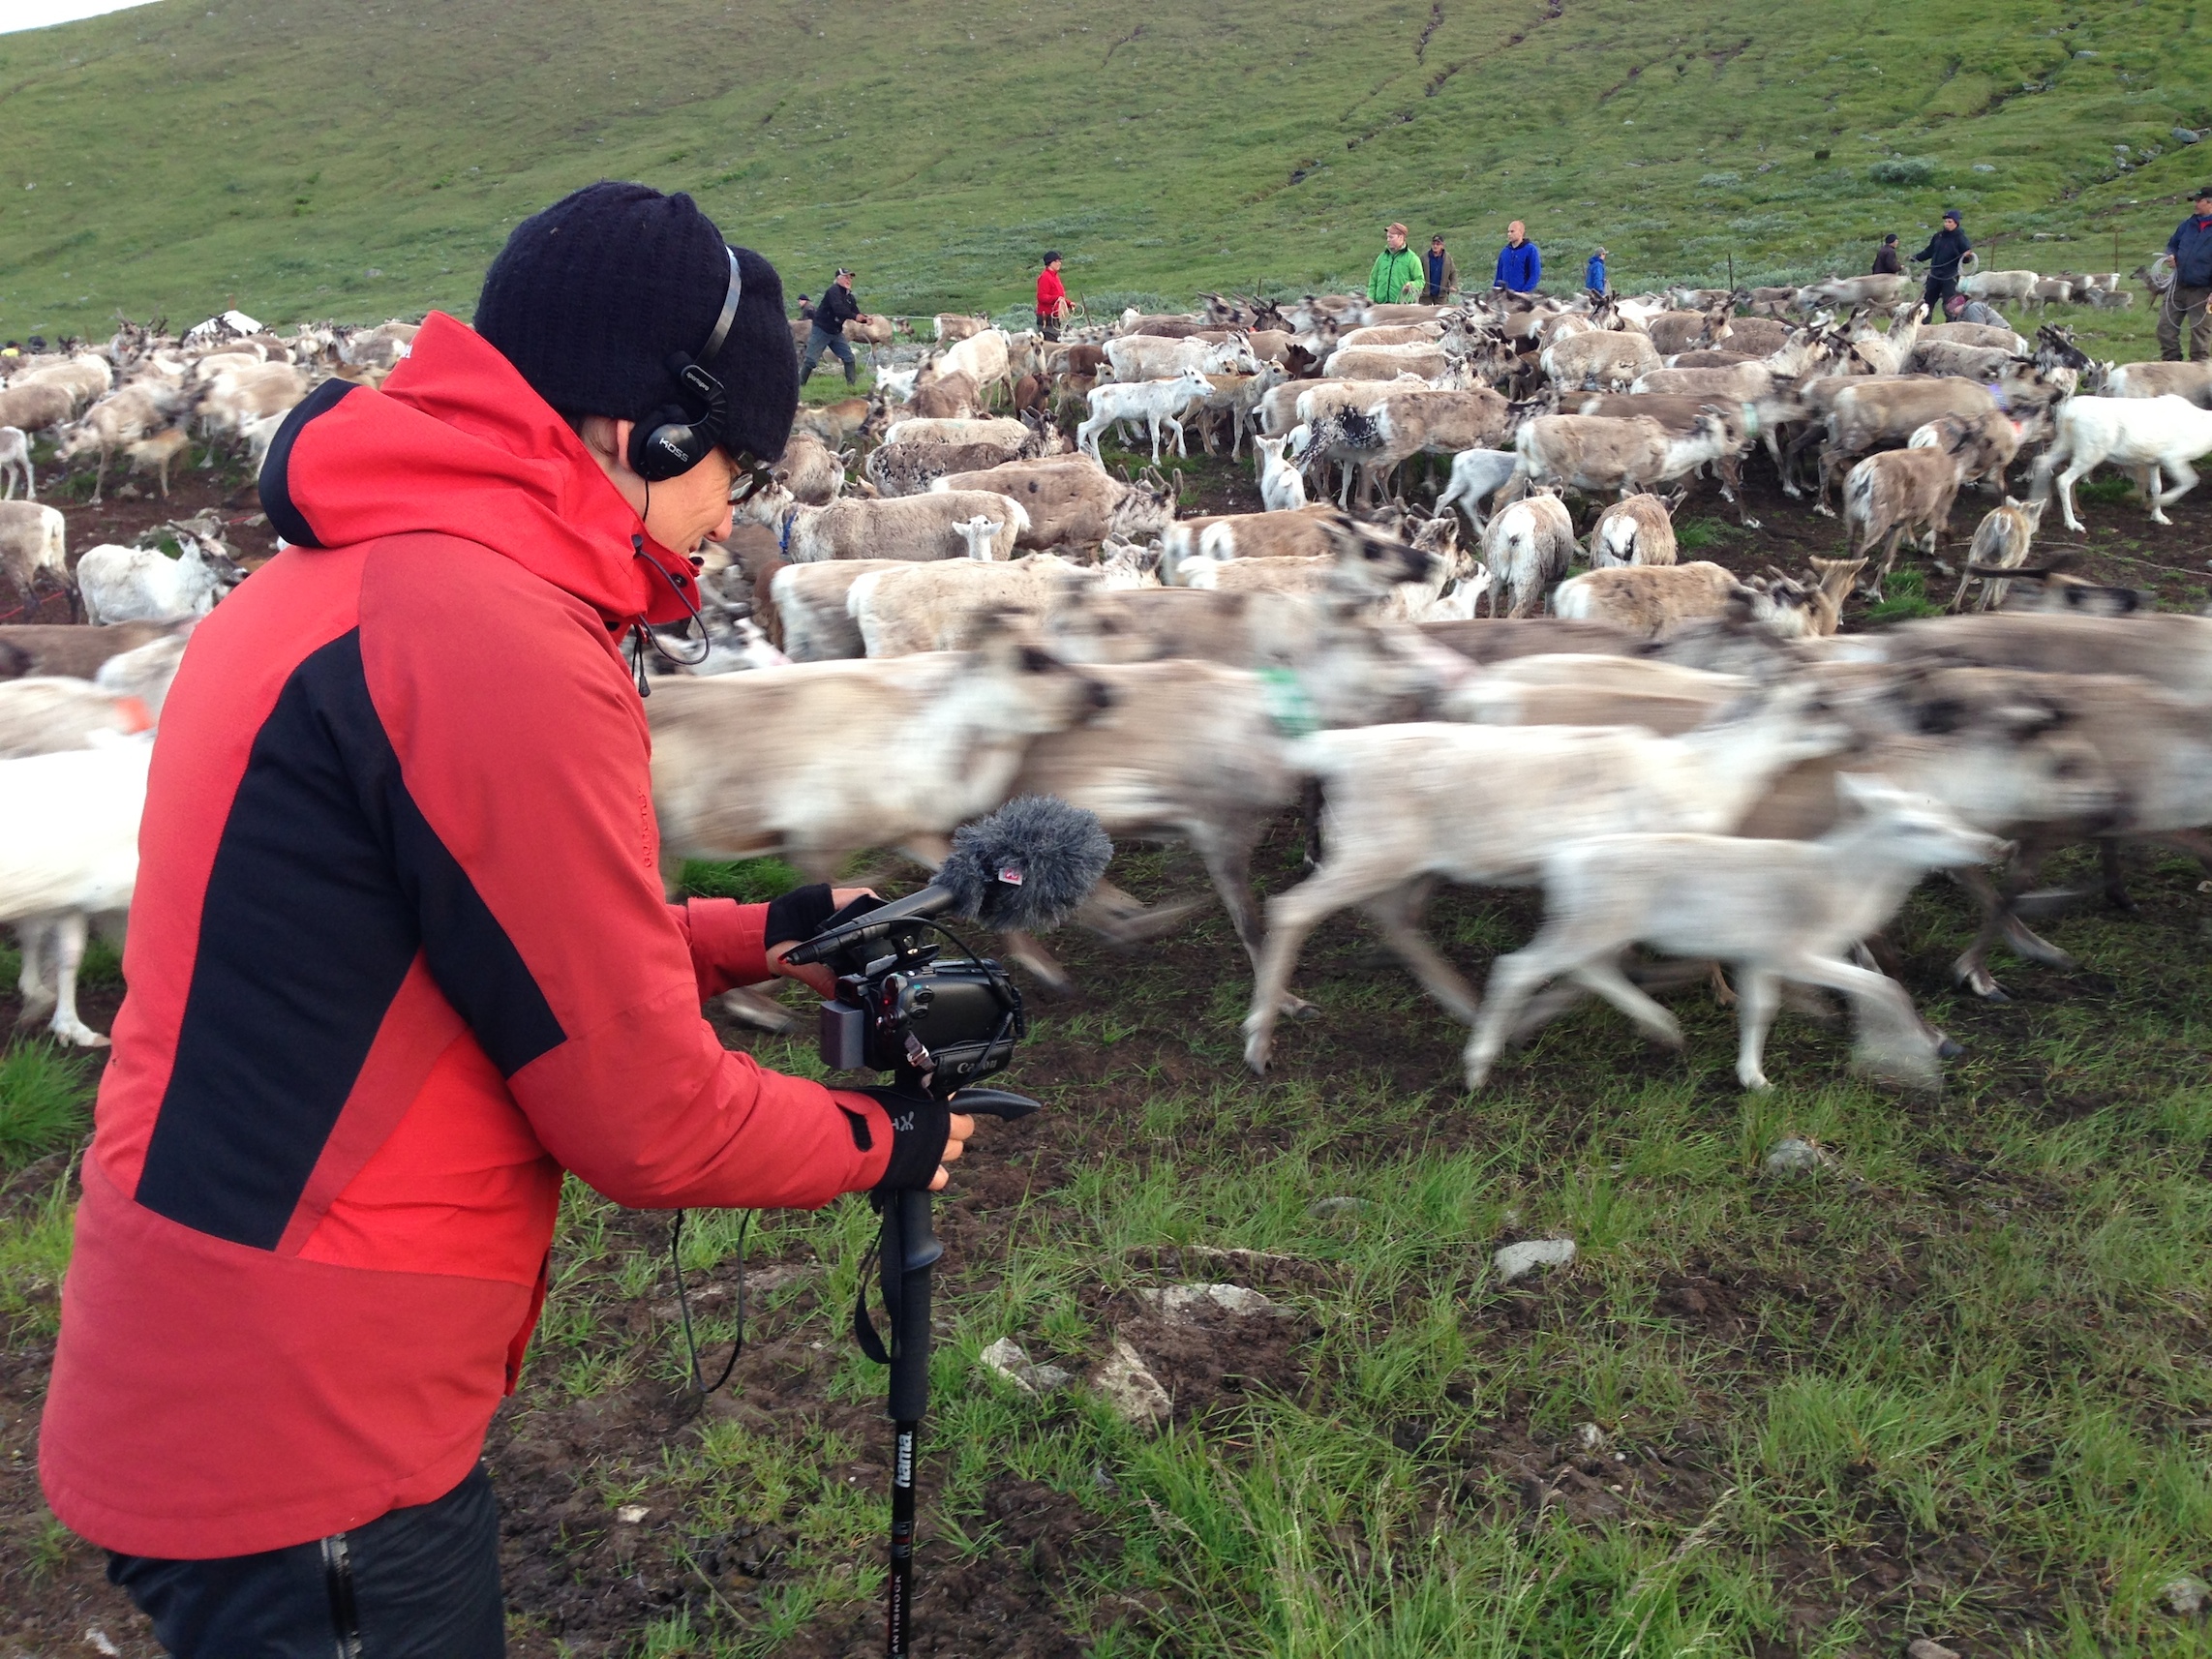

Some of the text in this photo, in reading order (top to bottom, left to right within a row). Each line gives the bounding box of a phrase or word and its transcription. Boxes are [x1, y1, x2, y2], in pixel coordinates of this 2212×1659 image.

[659, 437, 689, 463] KOSS
[956, 1060, 998, 1074] Caon
[892, 1574, 902, 1653] ANTISHOCK
